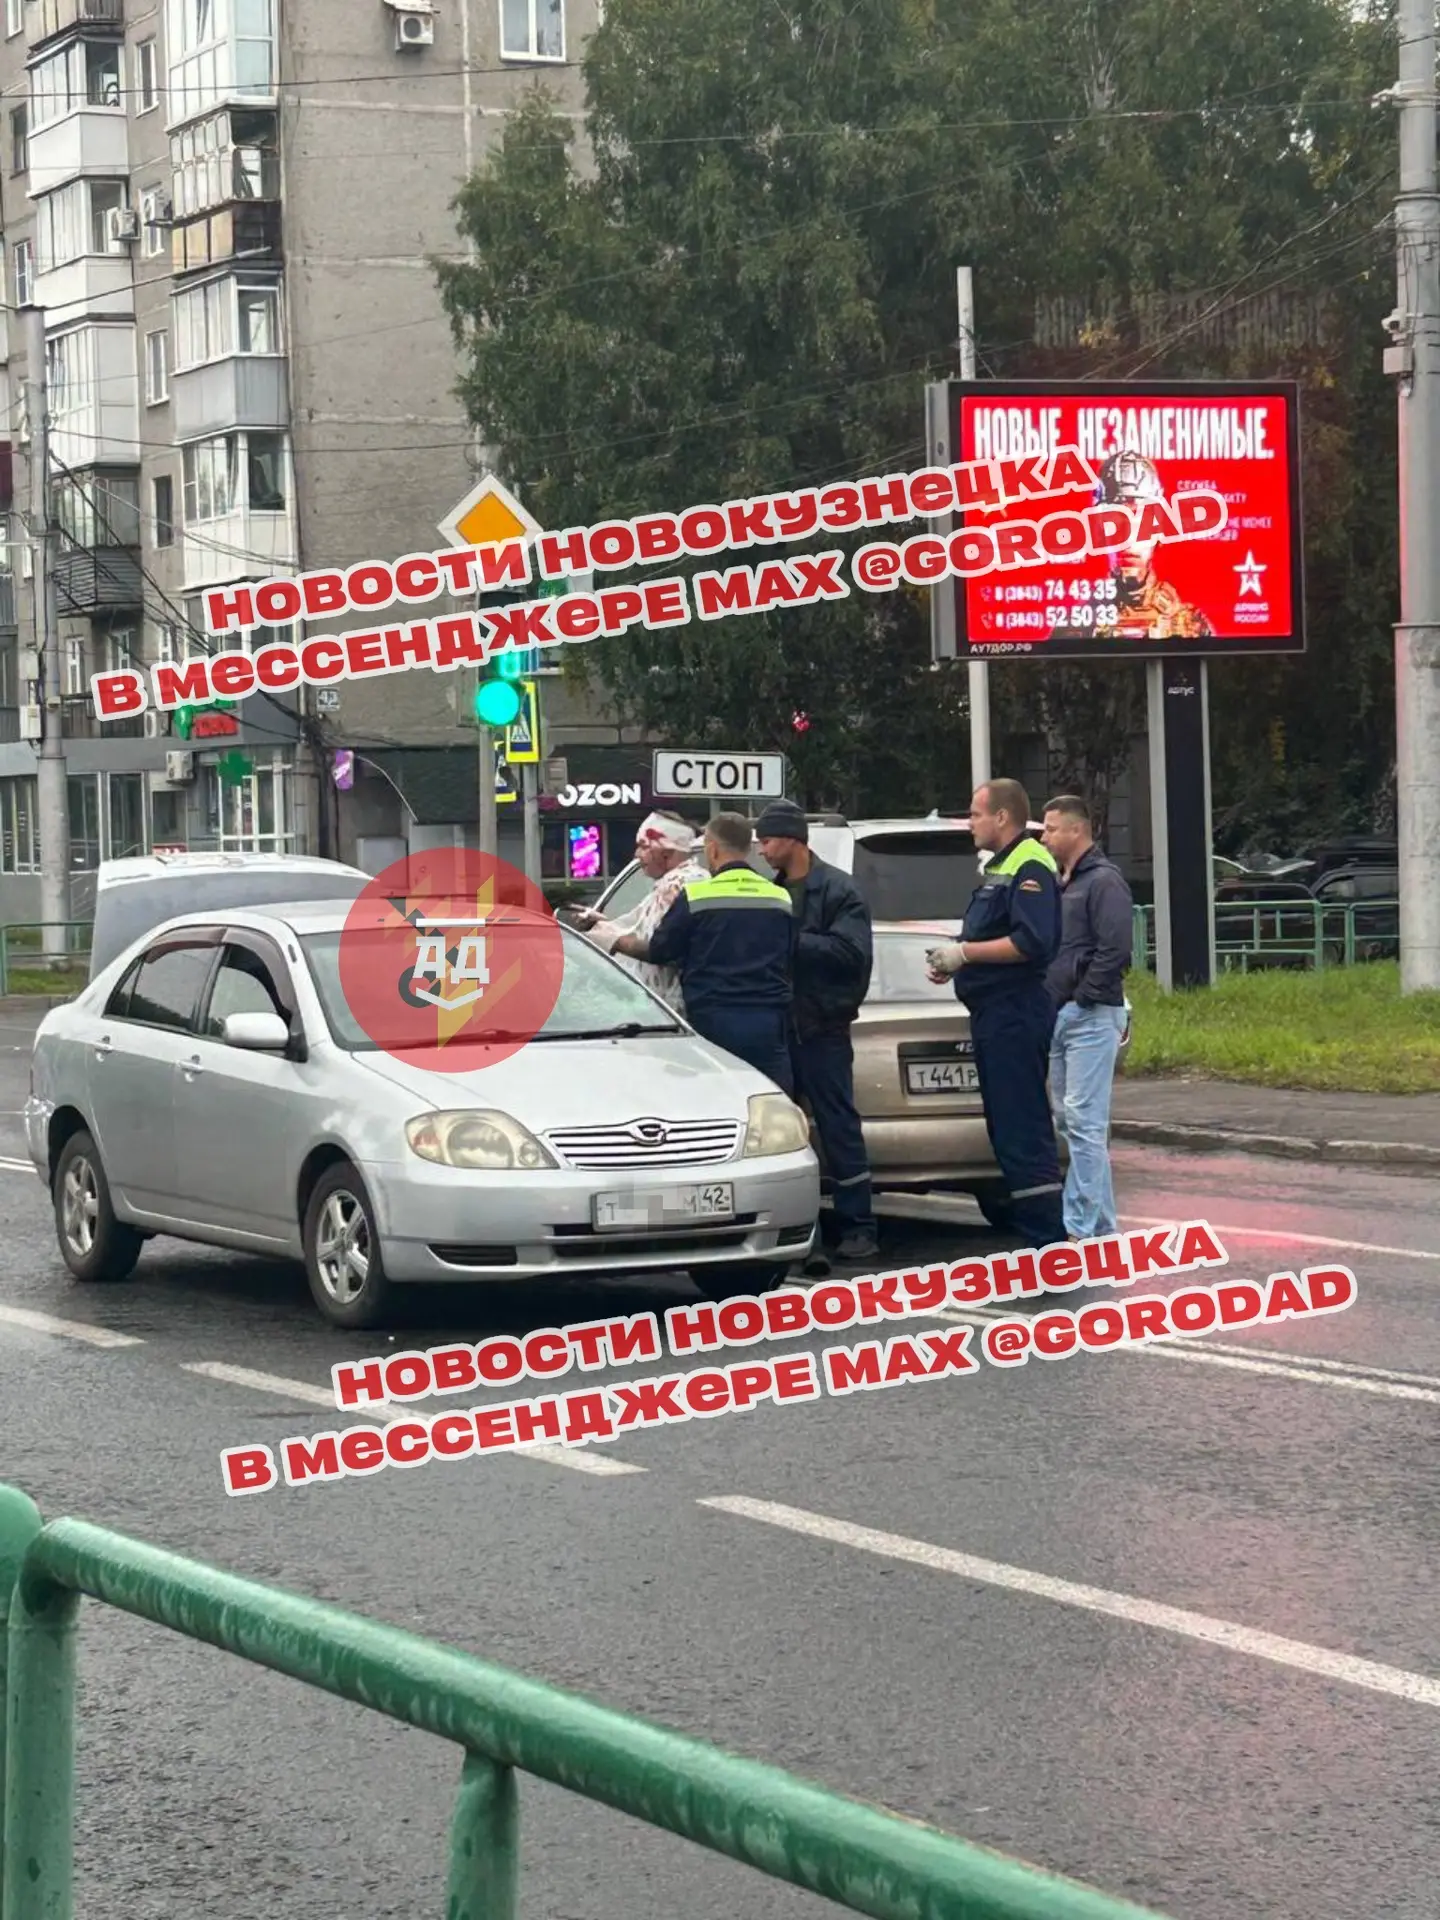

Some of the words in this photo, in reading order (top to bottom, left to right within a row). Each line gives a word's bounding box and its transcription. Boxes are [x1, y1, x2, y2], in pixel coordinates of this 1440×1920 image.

[974, 406, 1062, 460] НОВЫЕ
[1077, 406, 1275, 461] НЕЗАМЕНИМЫЕ.
[1045, 579, 1065, 600] 74
[1069, 579, 1091, 600] 43
[1094, 579, 1118, 600] 35
[1046, 606, 1068, 627] 52
[1070, 606, 1093, 627] 50
[1096, 604, 1119, 626] 33
[672, 759, 763, 790] СТОП
[558, 783, 641, 806] OZON
[702, 1186, 724, 1211] 42
